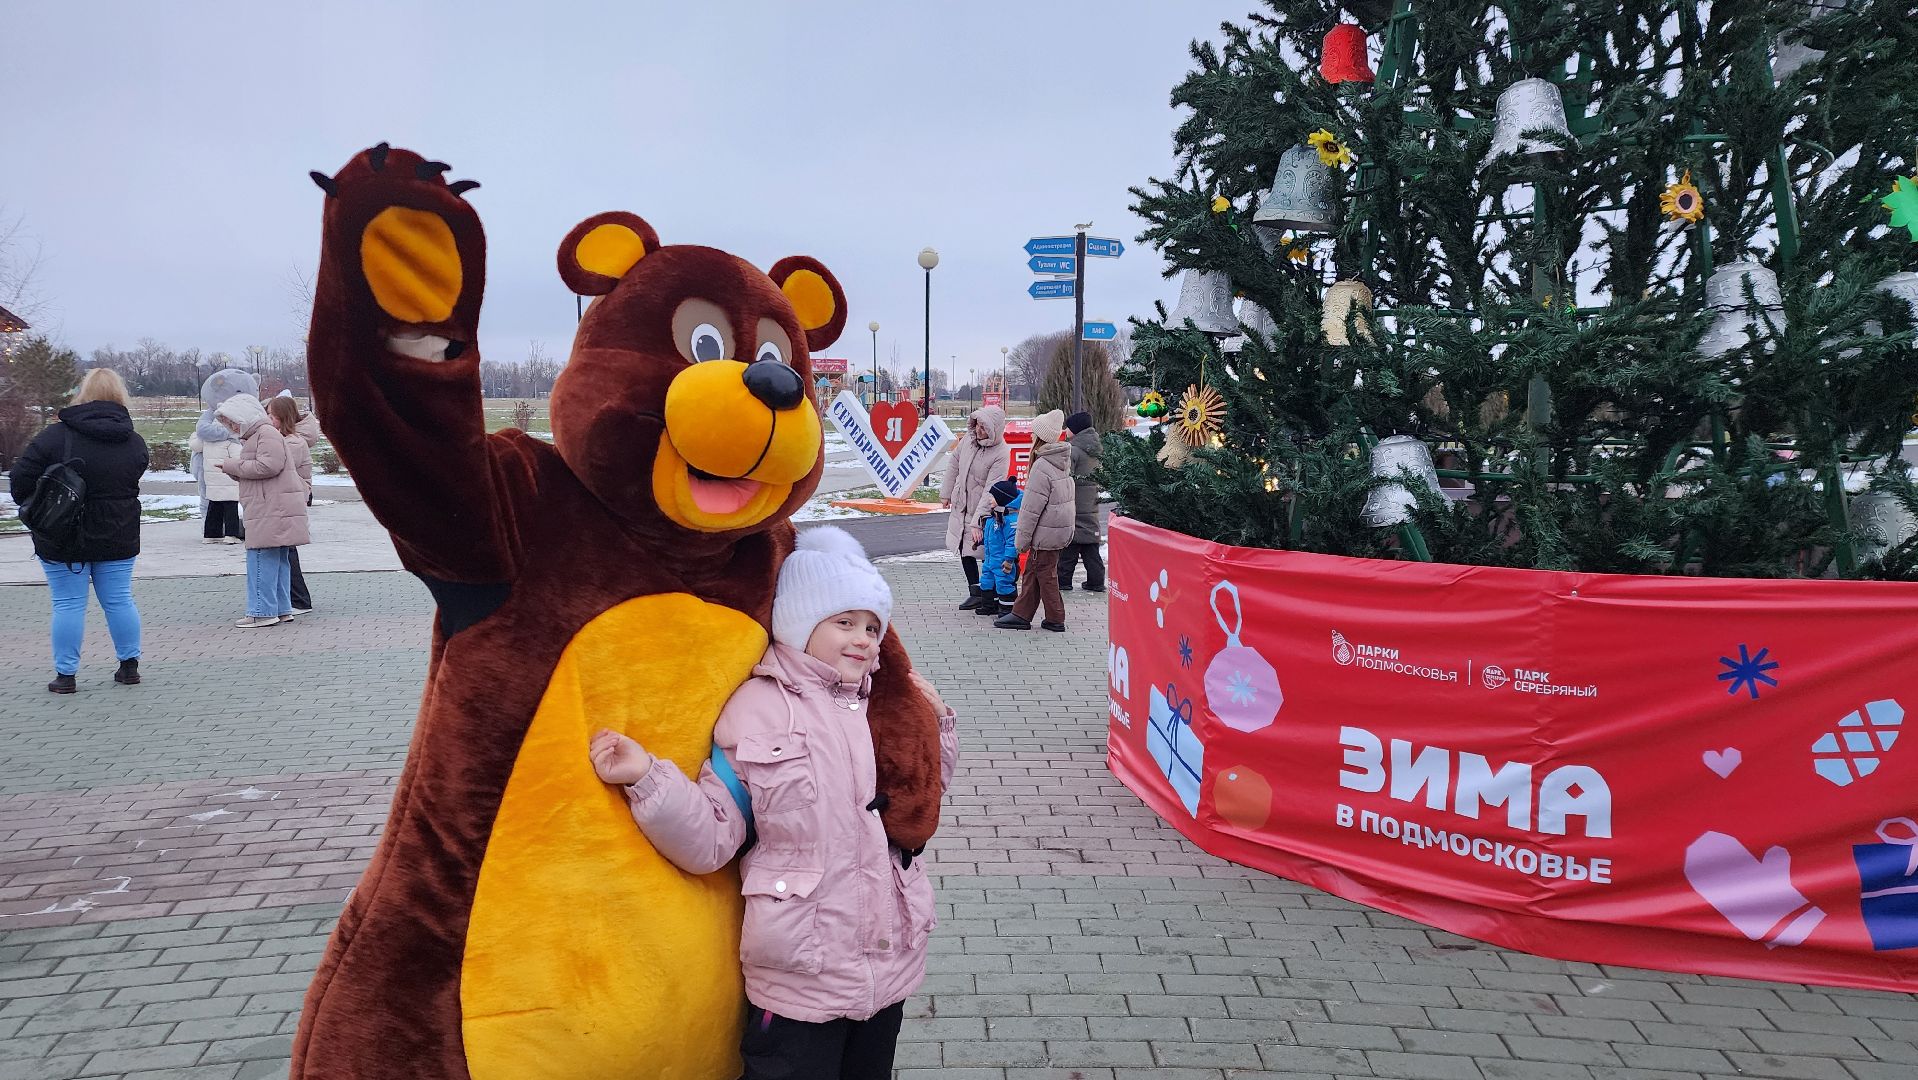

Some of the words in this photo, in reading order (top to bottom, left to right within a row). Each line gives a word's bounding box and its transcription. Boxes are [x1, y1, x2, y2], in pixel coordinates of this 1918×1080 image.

[1037, 260, 1057, 268] Туалет
[1059, 261, 1070, 269] WC
[884, 417, 903, 442] Я
[833, 401, 902, 496] СЕРЕБРЯНЫЕ
[897, 424, 942, 481] ПРУДЫ
[1357, 644, 1399, 660] ПАРКИ
[1356, 656, 1457, 682] ПОДМОСКОВЬЯ
[1514, 668, 1550, 683] ПАРК
[1514, 680, 1597, 697] СЕРЕБРЯНЫЙ
[1339, 726, 1612, 838] ЗИМА
[1336, 804, 1353, 828] В
[1360, 810, 1612, 884] ПОДМОСКОВЬЕ
